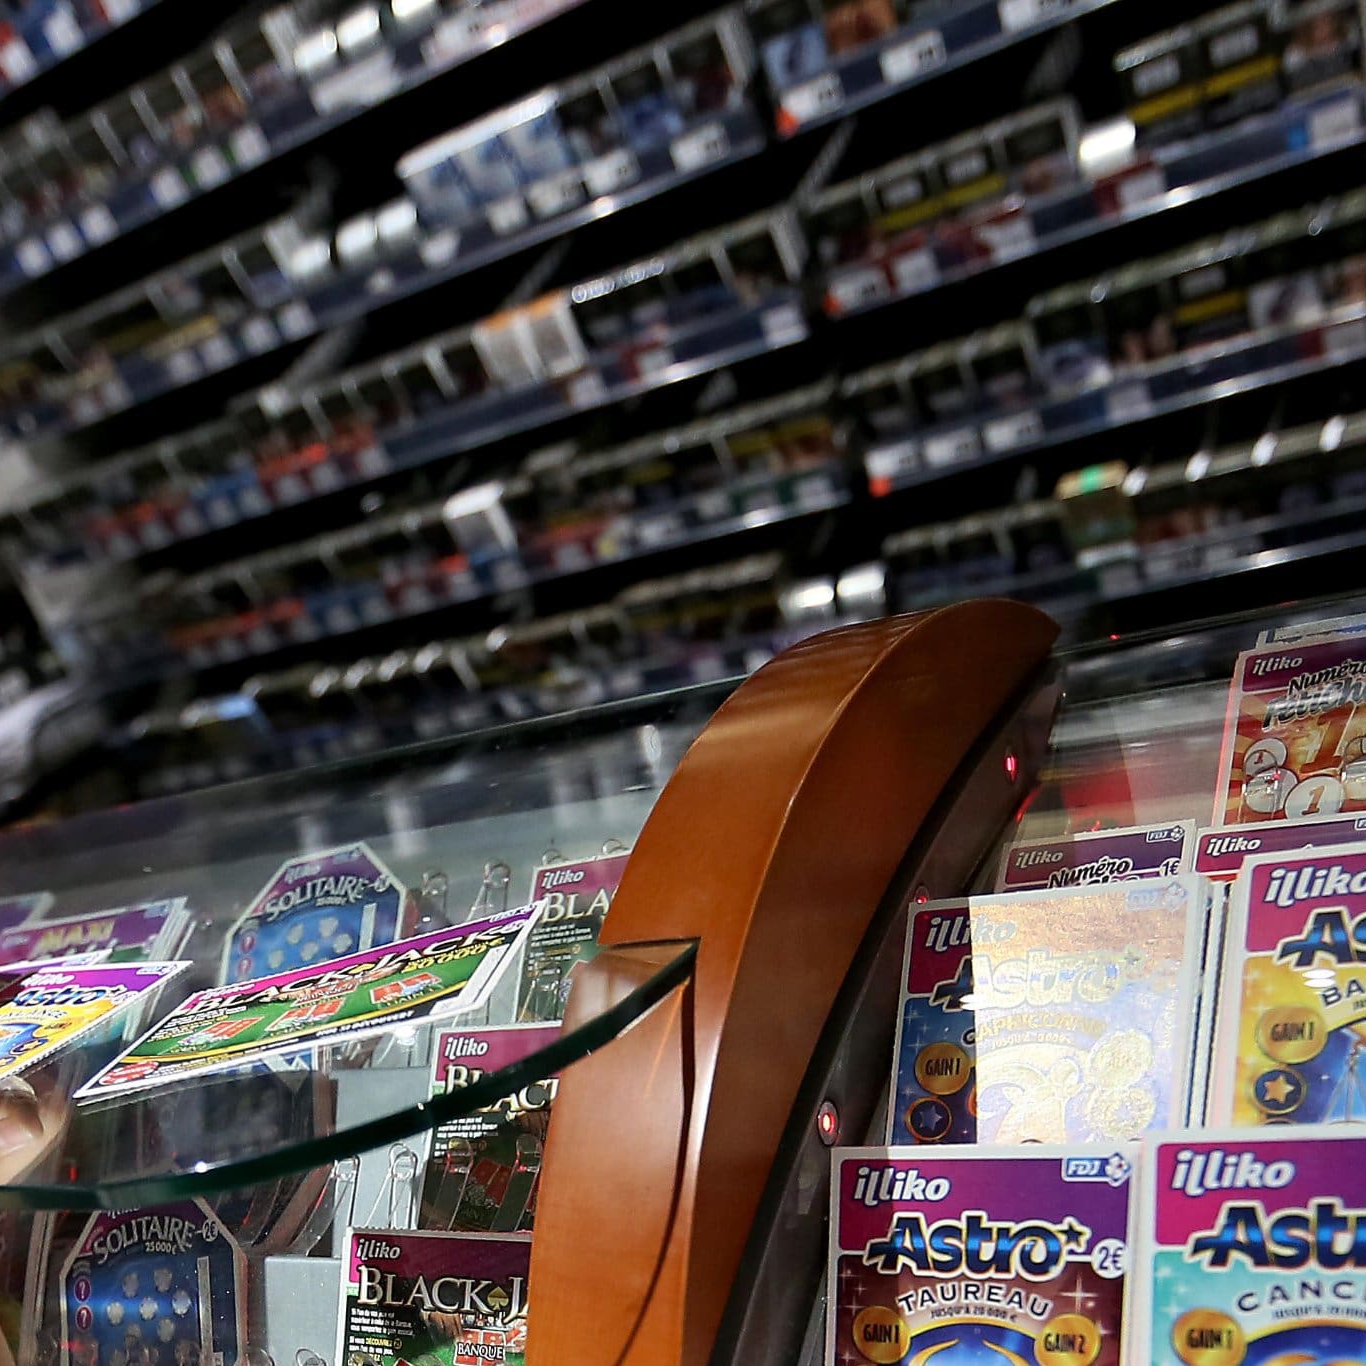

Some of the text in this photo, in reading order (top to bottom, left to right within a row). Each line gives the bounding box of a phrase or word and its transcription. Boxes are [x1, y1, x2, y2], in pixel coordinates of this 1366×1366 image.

[1253, 653, 1303, 675] illiko
[1148, 829, 1169, 841] FDJ
[1206, 837, 1261, 856] illiko
[1015, 849, 1063, 868] illiko
[1161, 860, 1180, 877] 1€
[541, 869, 584, 889] illiko
[1048, 857, 1133, 889] Numéro
[266, 876, 368, 922] SOLITAIRE
[926, 914, 1016, 952] illiko
[933, 950, 1121, 1011] Astro
[445, 1037, 488, 1060] illiko
[925, 1057, 952, 1078] GAIN
[1067, 1159, 1100, 1176] FDJ
[1172, 1149, 1296, 1195] illiko
[854, 1167, 951, 1205] illiko
[92, 1215, 196, 1265] SOLITAIRE
[356, 1238, 401, 1267] illiko
[866, 1215, 1062, 1277] Astro
[1098, 1246, 1124, 1271] 2€
[357, 1264, 494, 1314] BLACK
[897, 1283, 1051, 1319] TAUREAU
[863, 1323, 892, 1344] GAIN
[456, 1342, 506, 1361] BANQUE
